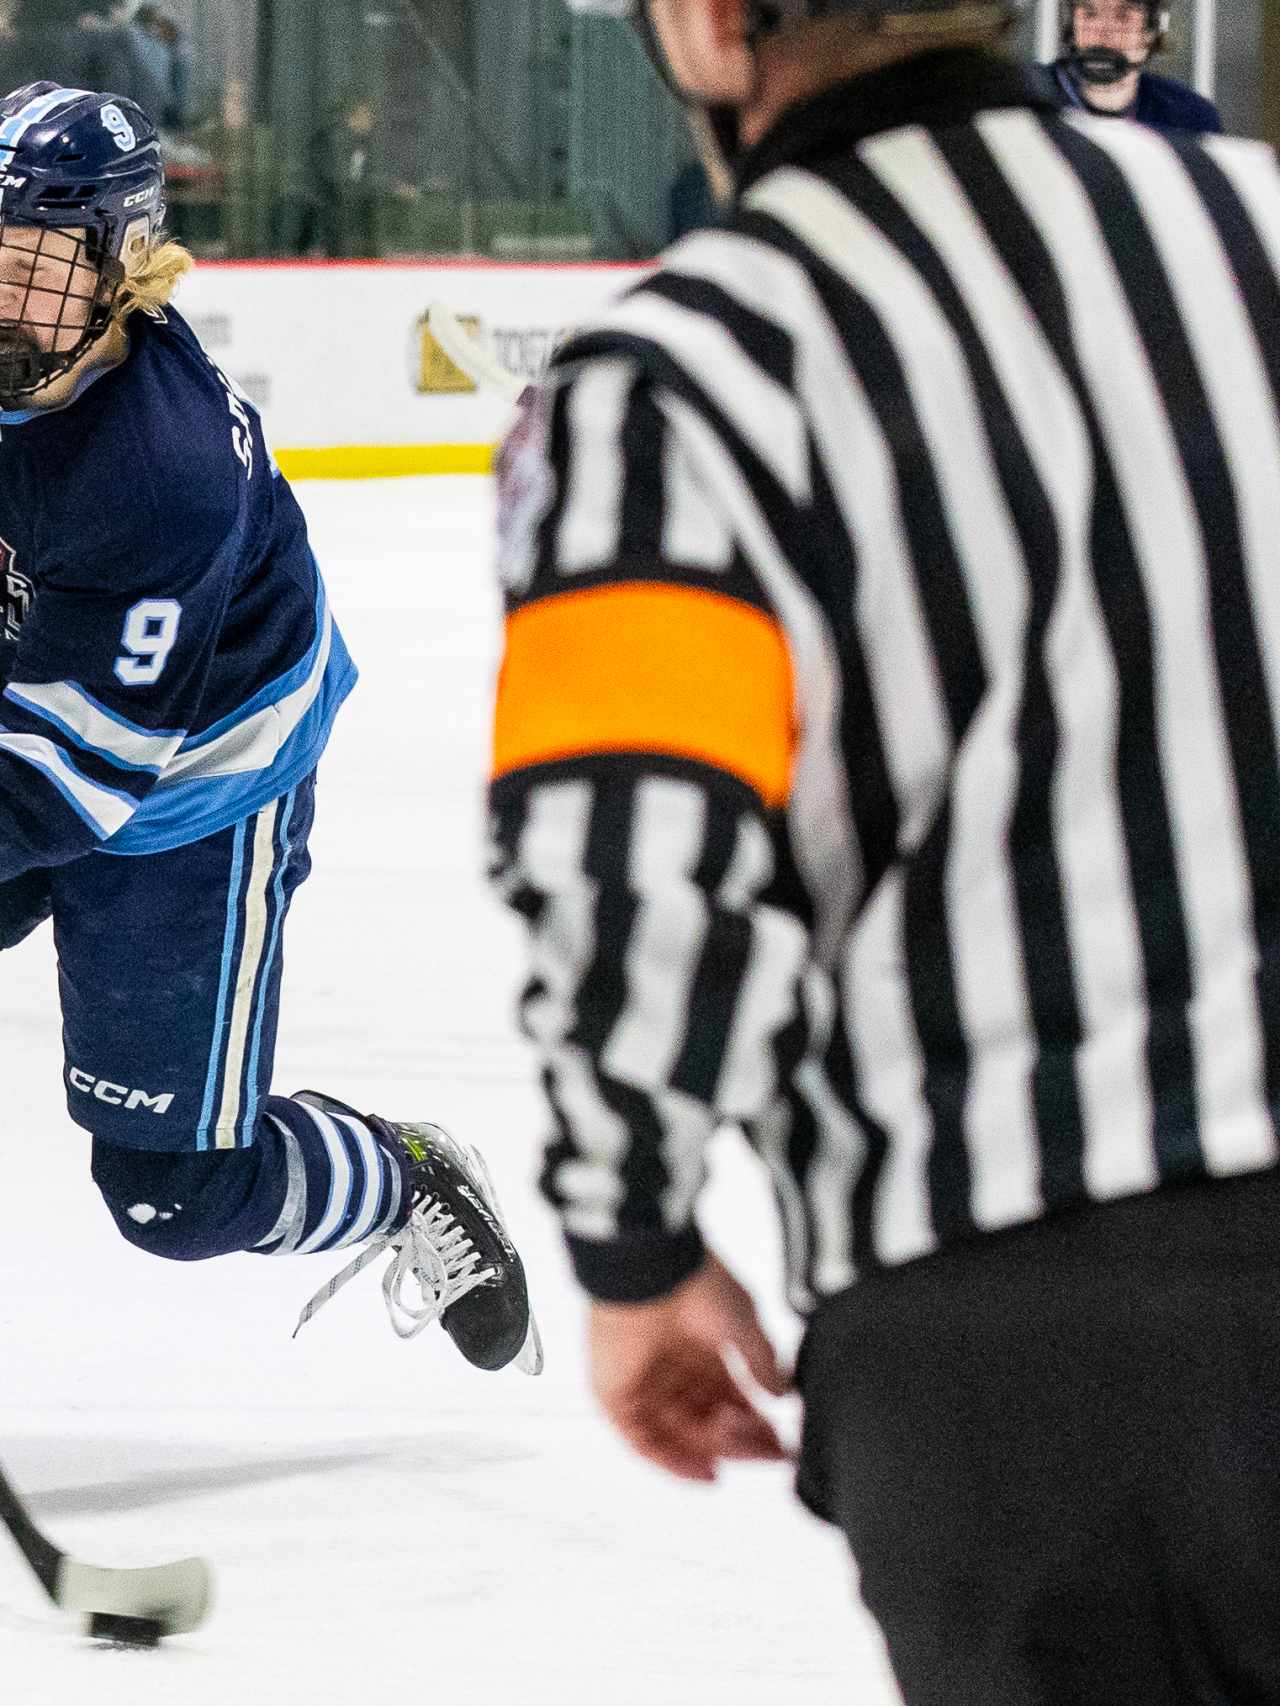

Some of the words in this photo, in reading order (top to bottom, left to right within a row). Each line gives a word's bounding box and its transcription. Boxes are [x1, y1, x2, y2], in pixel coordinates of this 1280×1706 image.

[101, 104, 136, 152] 9
[113, 598, 182, 686] 9
[70, 1067, 175, 1114] CCM
